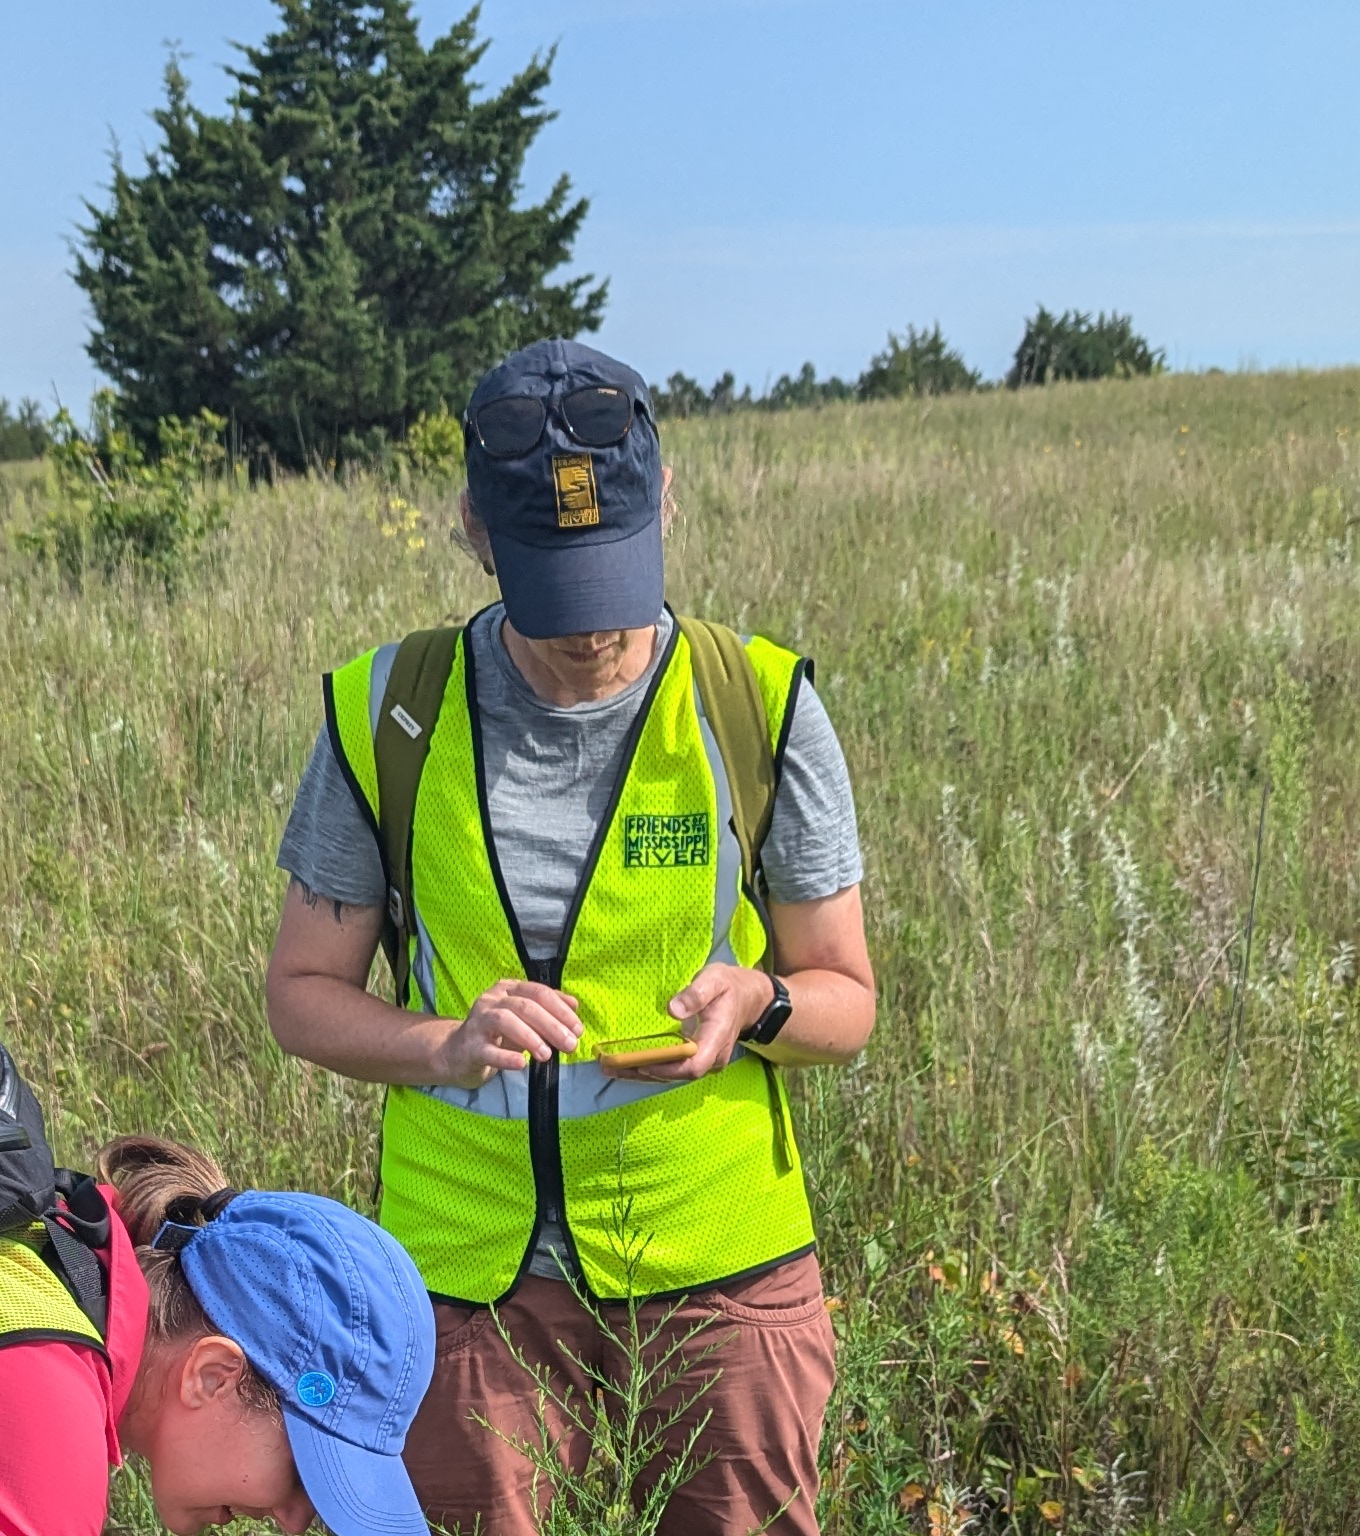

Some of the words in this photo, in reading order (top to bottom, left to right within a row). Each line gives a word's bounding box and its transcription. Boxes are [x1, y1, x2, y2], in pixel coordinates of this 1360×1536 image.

[627, 817, 691, 834] FRIENDS
[627, 834, 707, 850] MISSISSIPPI
[627, 849, 706, 866] RIVER
